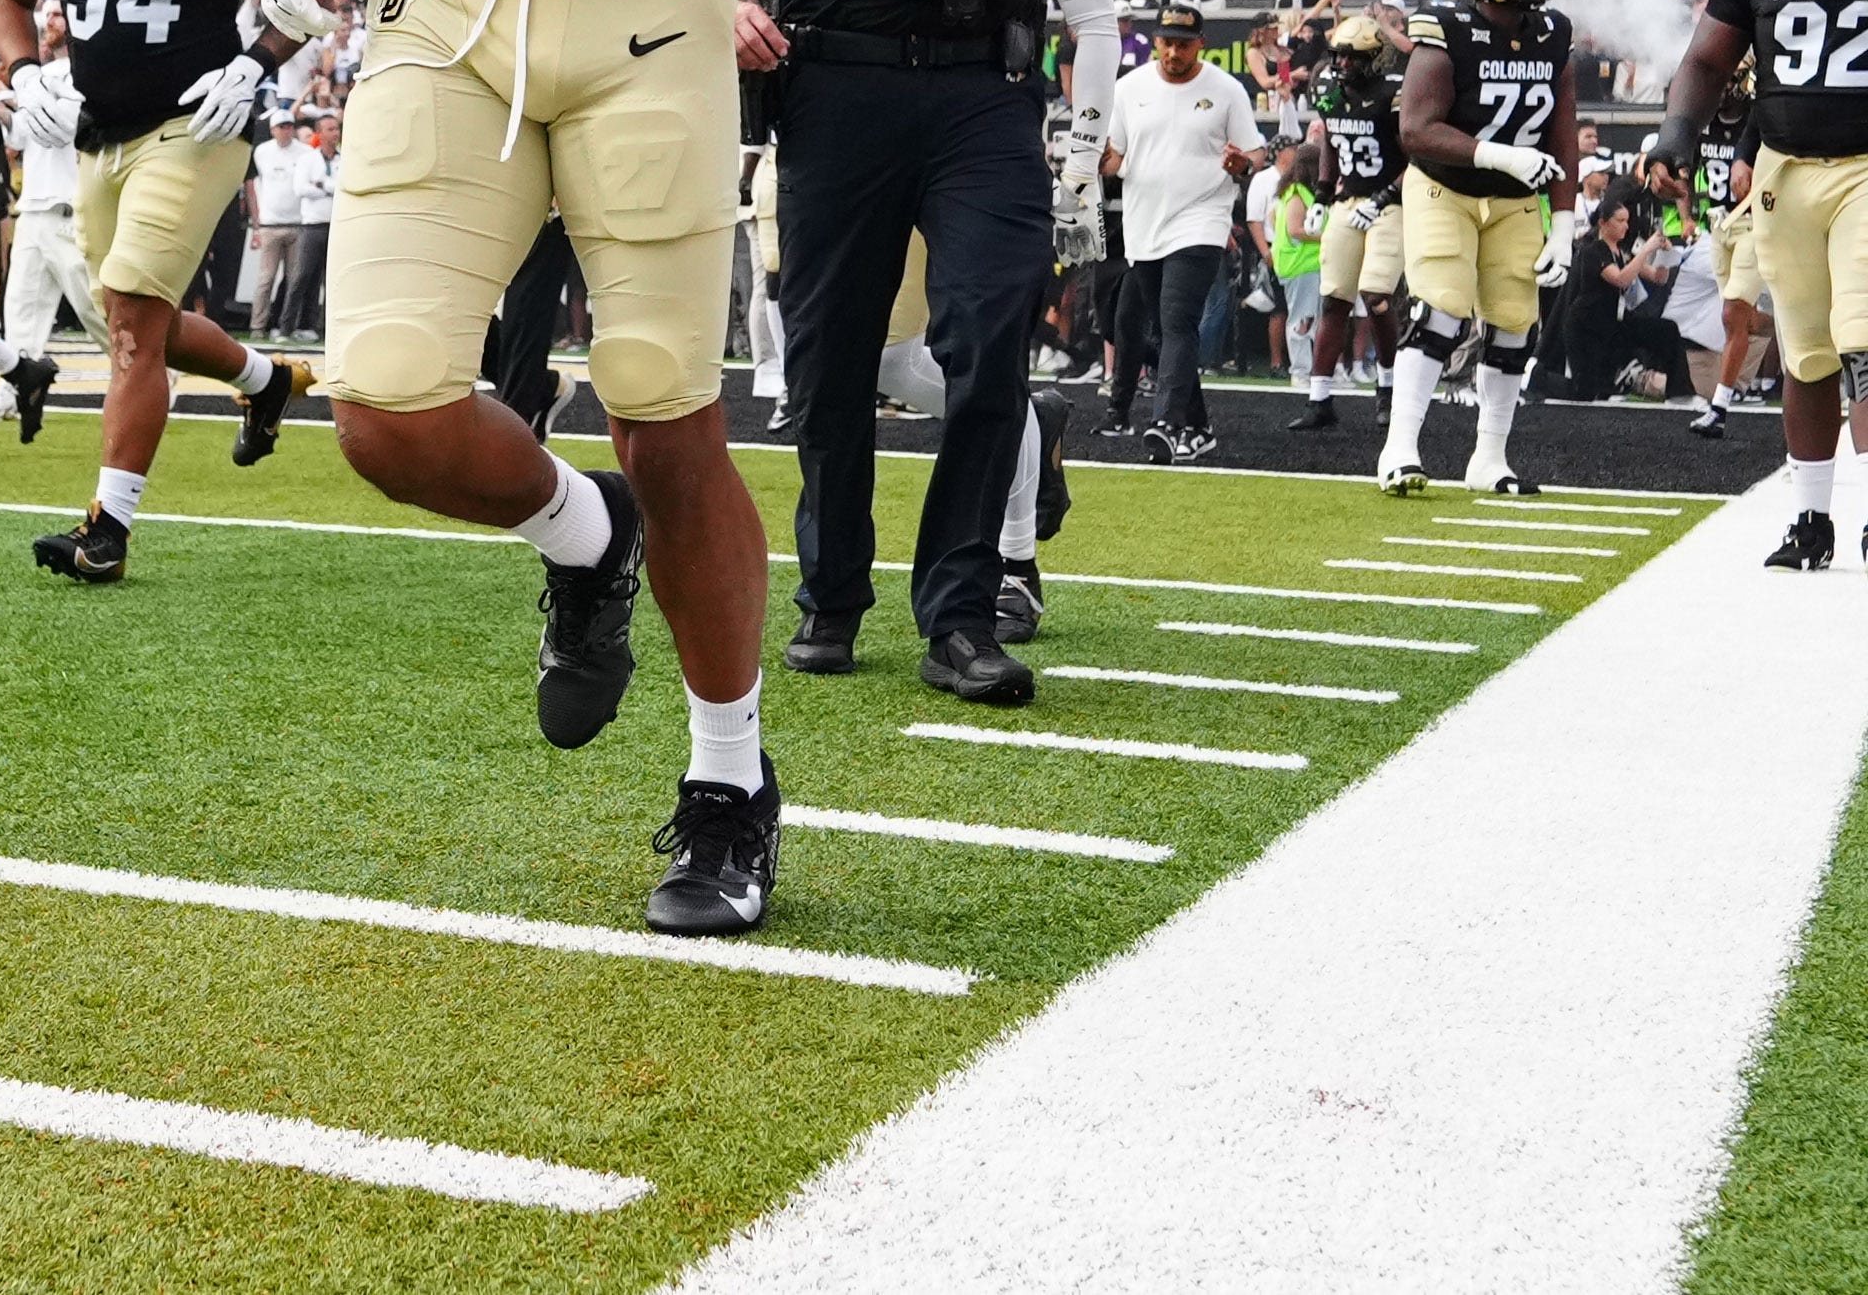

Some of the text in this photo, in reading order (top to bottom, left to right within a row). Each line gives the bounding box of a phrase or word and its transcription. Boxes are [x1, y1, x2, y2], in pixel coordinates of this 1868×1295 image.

[1773, 1, 1868, 88] 92
[1479, 60, 1553, 80] COLORADO
[1326, 118, 1375, 134] COLORADO
[1475, 83, 1555, 146] 72
[1701, 143, 1735, 159] COLOR
[1705, 159, 1737, 202] 8
